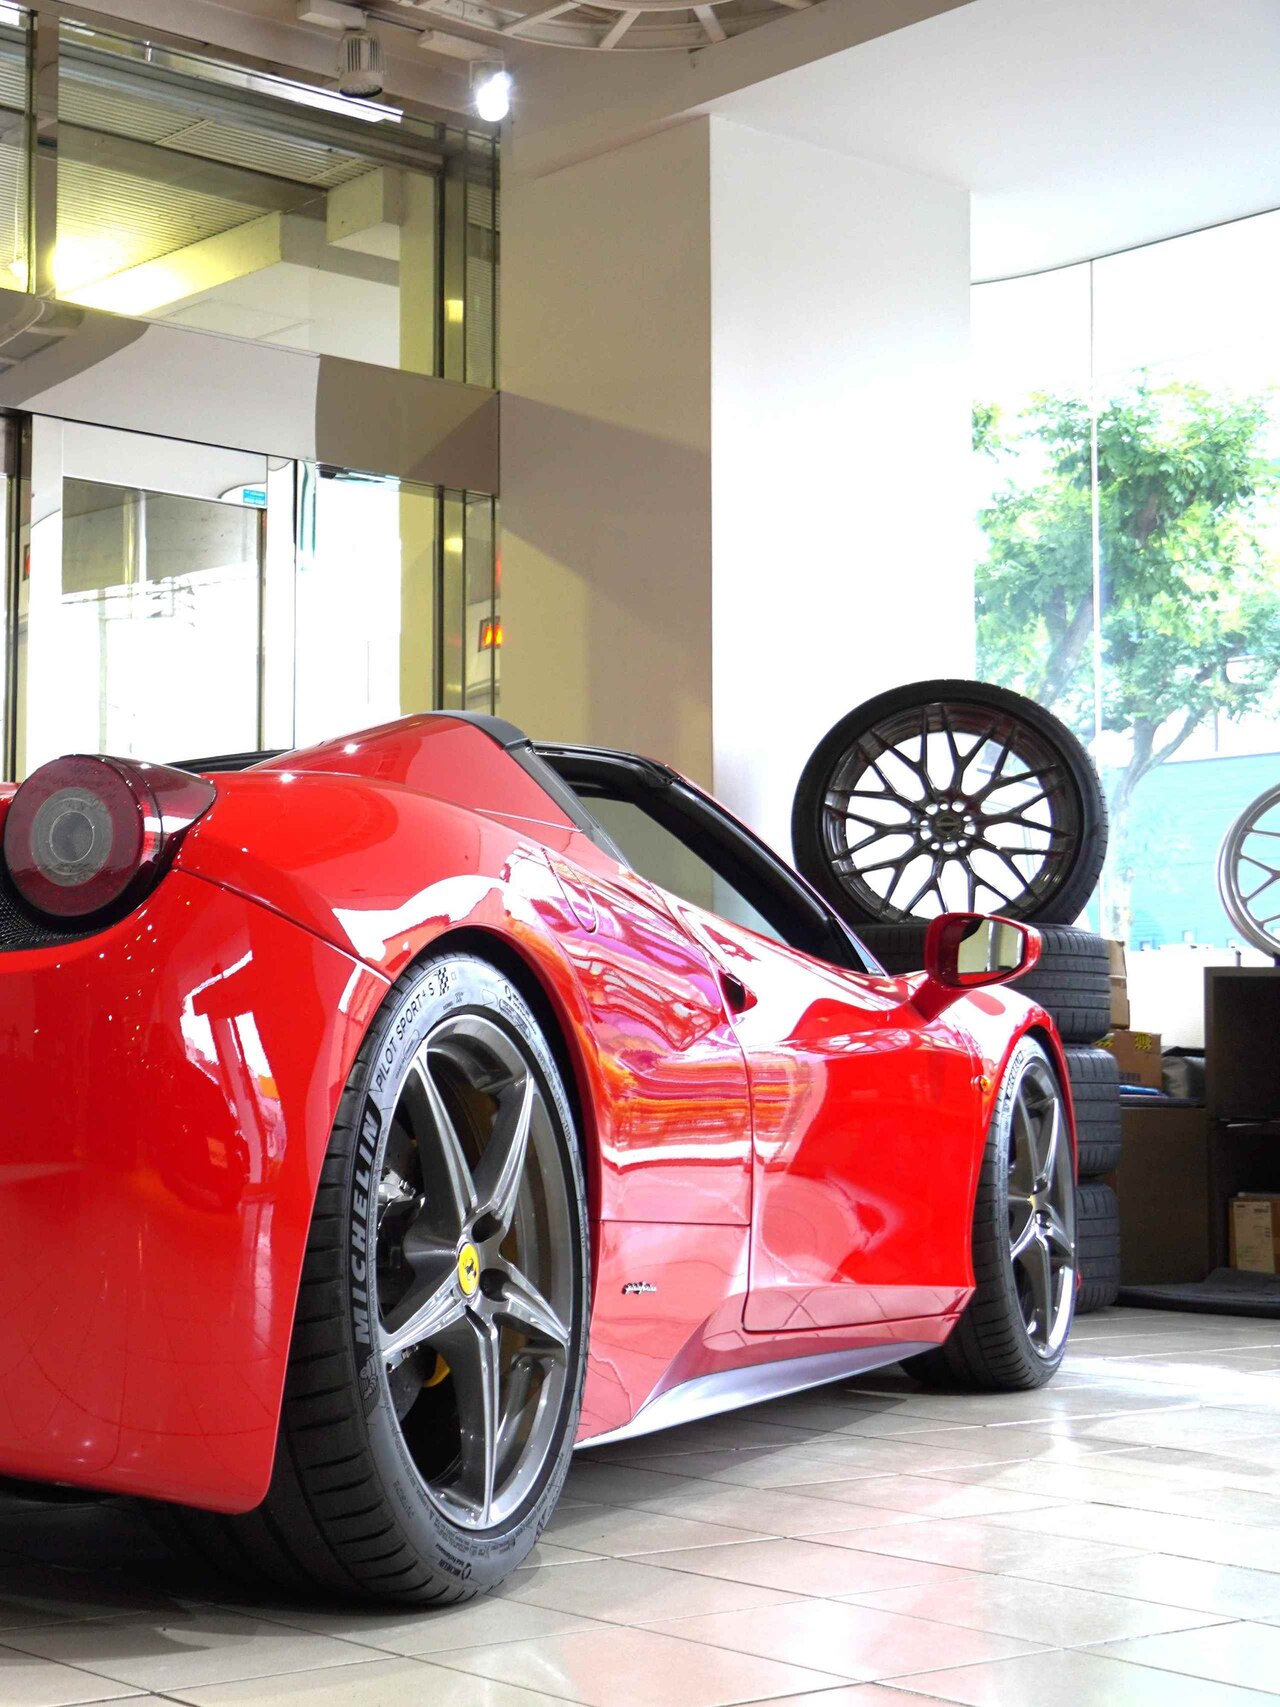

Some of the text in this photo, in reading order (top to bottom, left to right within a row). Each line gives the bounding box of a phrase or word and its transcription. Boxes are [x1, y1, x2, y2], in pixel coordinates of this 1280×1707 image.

[375, 1037, 397, 1089] PILOT
[395, 993, 422, 1041] SPORT
[350, 1110, 380, 1345] MICHELIN
